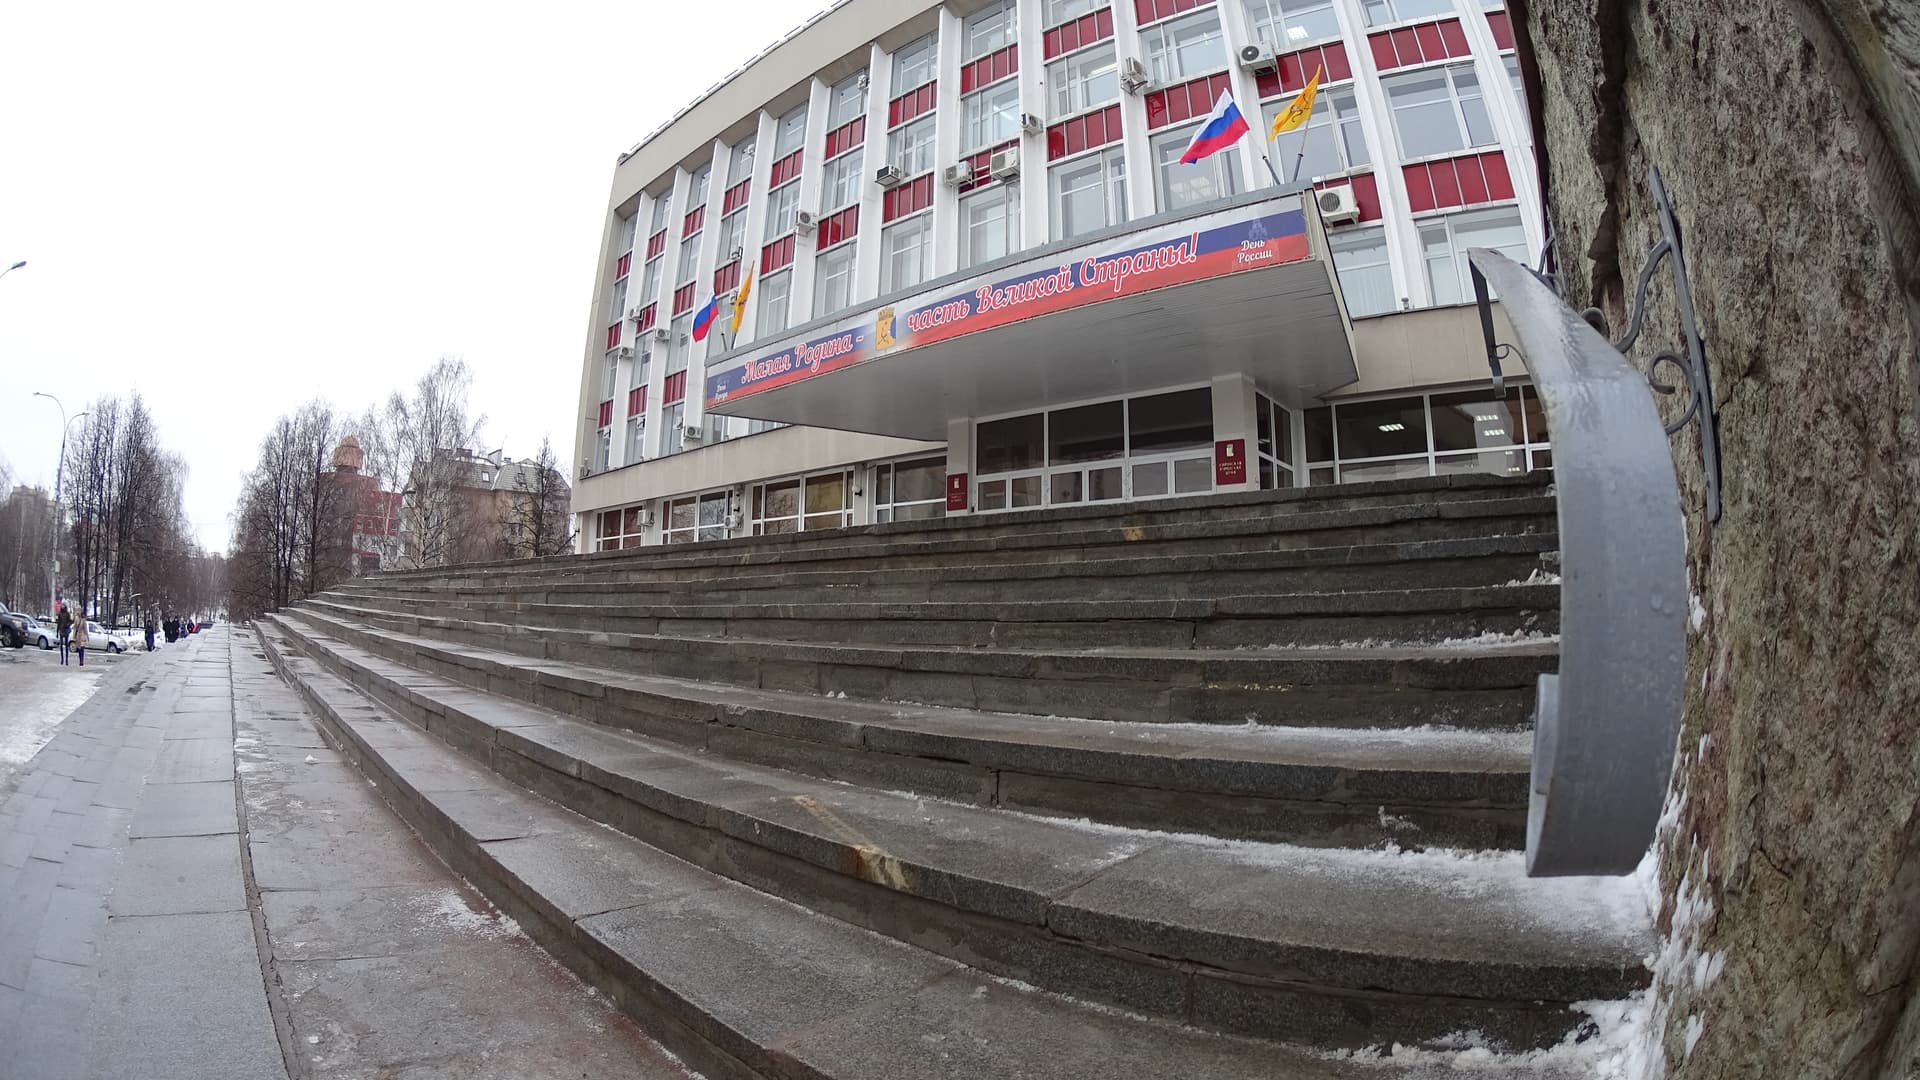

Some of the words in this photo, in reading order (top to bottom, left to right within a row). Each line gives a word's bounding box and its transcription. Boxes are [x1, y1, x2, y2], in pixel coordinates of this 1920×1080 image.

[1241, 240, 1266, 251] День
[1237, 249, 1272, 262] России
[742, 354, 791, 383] Малая
[794, 333, 853, 373] Родина
[907, 299, 970, 332] часть
[975, 264, 1073, 313] Великой
[1080, 231, 1199, 292] Страны!
